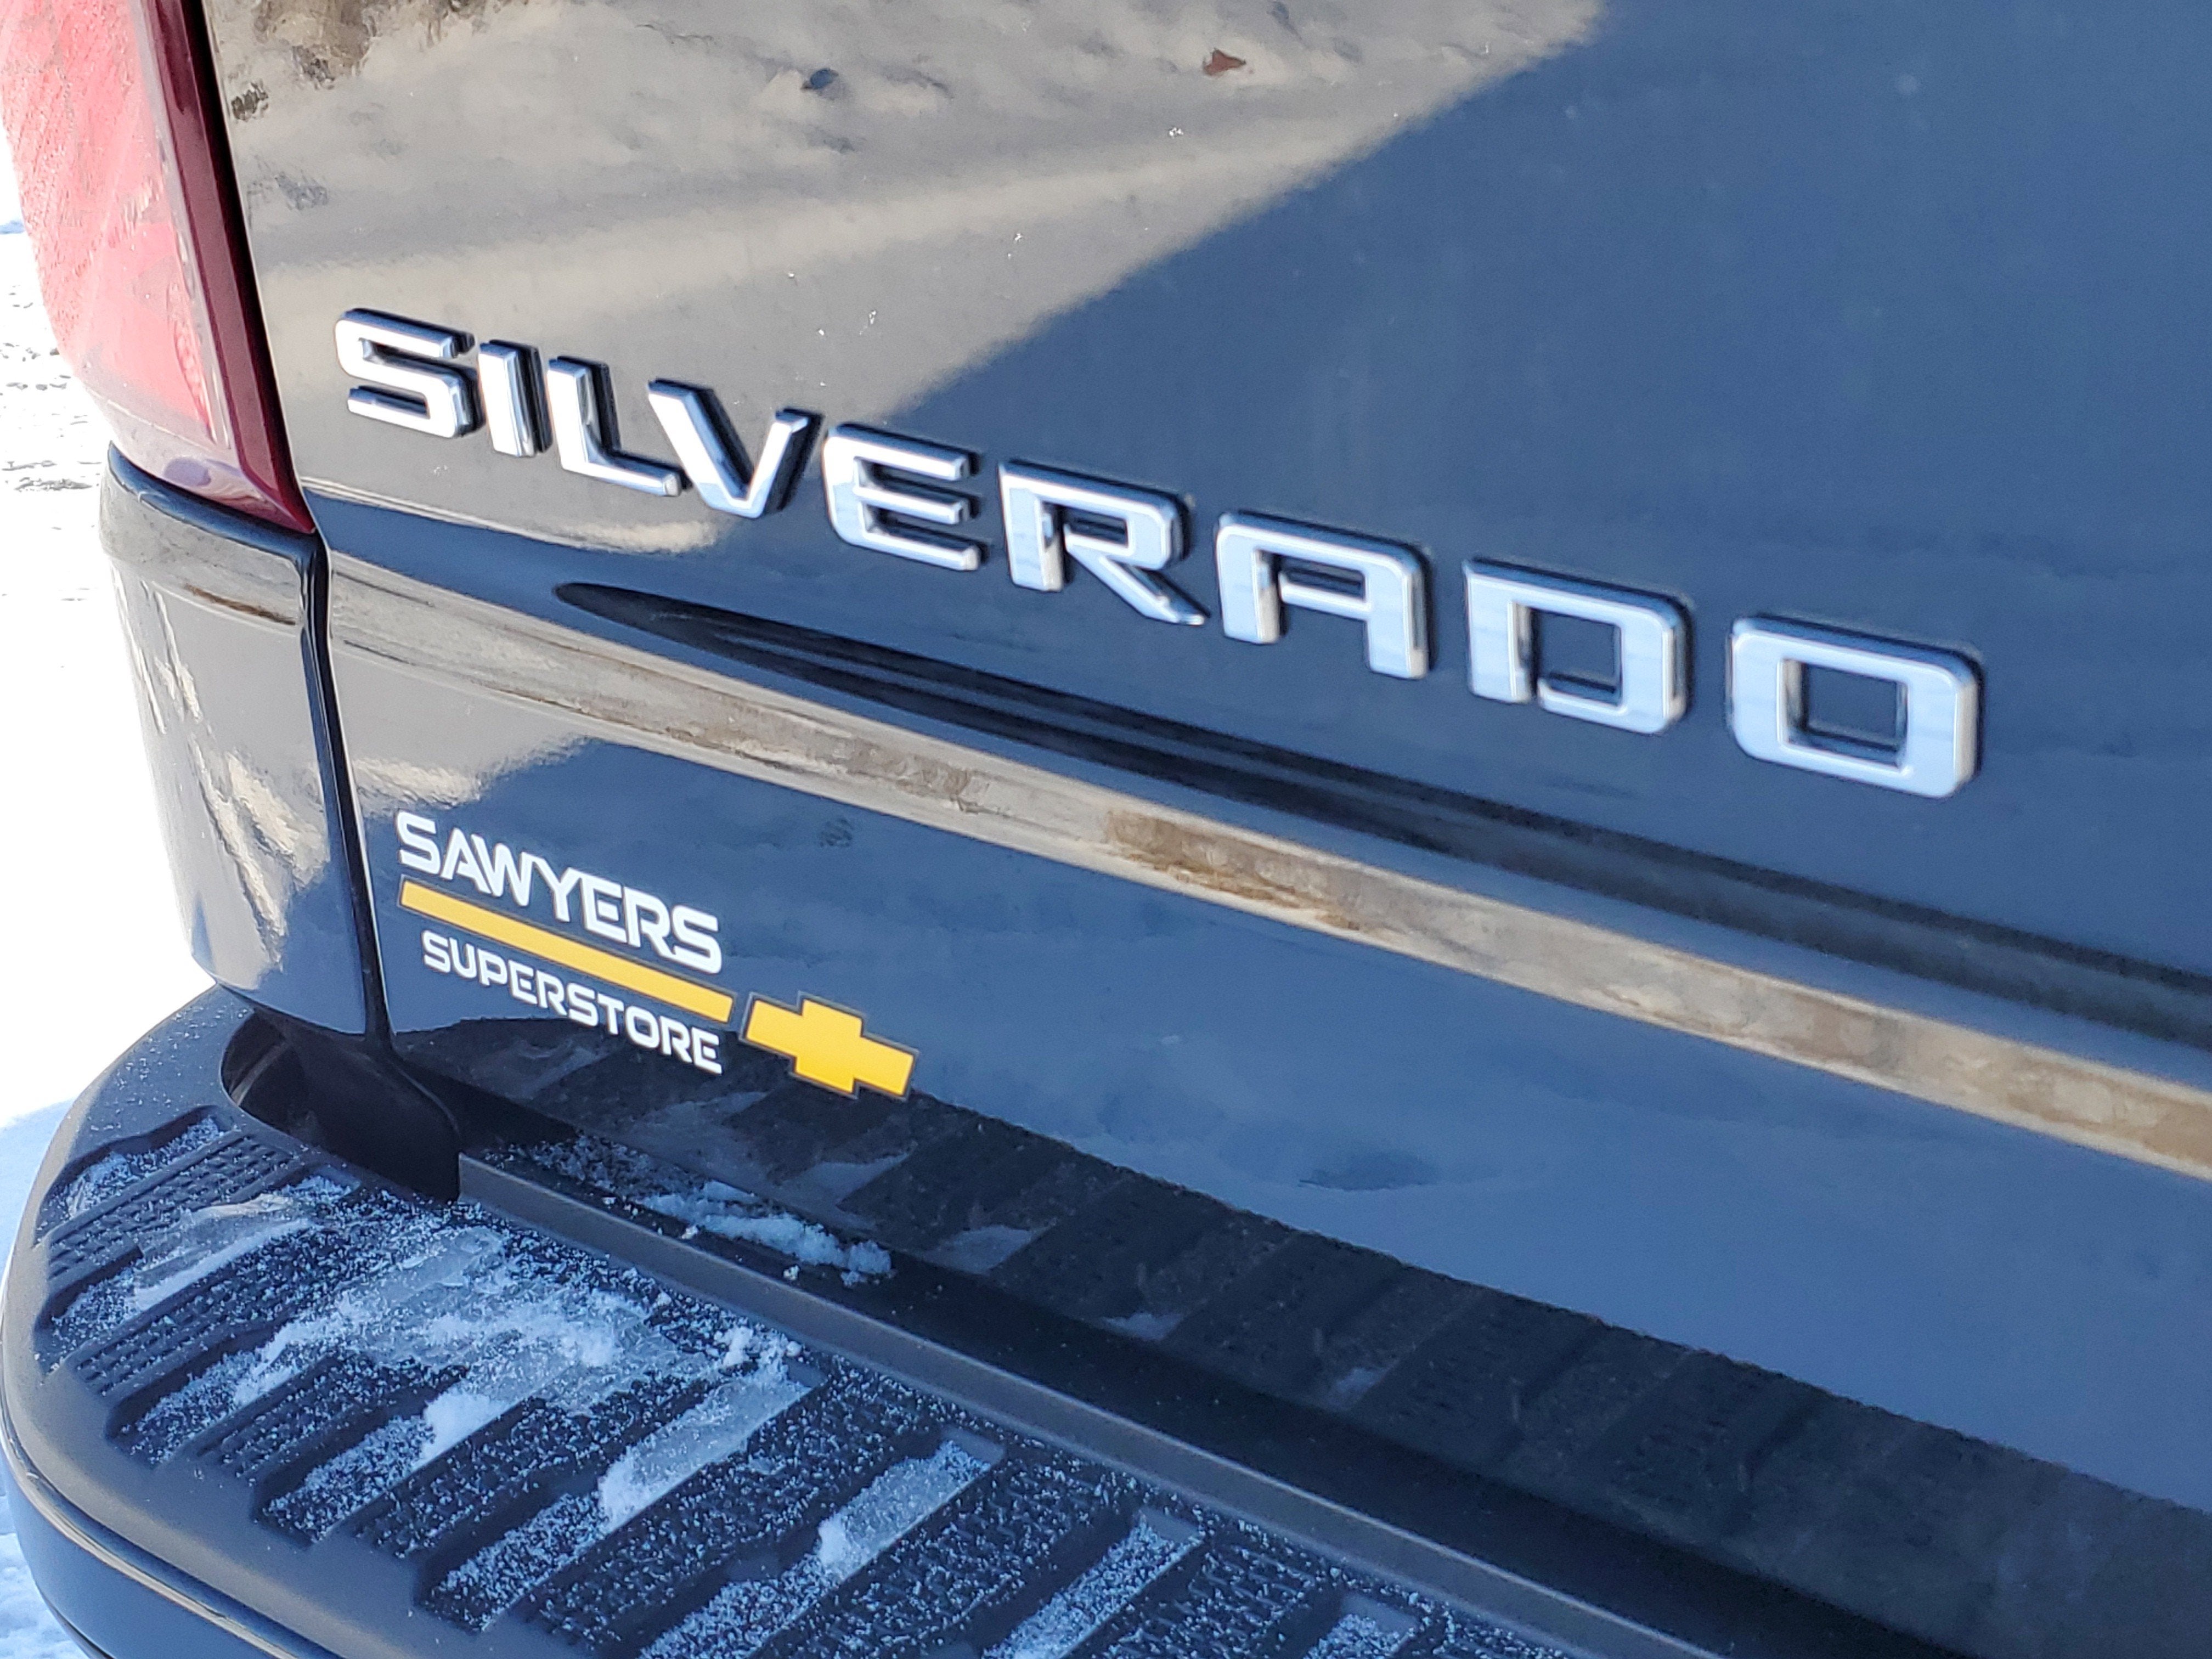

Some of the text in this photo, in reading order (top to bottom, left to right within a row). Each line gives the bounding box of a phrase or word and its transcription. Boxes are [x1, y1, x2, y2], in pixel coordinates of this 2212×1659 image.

[334, 308, 1983, 799] SILVERADO
[396, 810, 723, 974] SAWYERS
[421, 929, 724, 1075] SUPERSTORE
